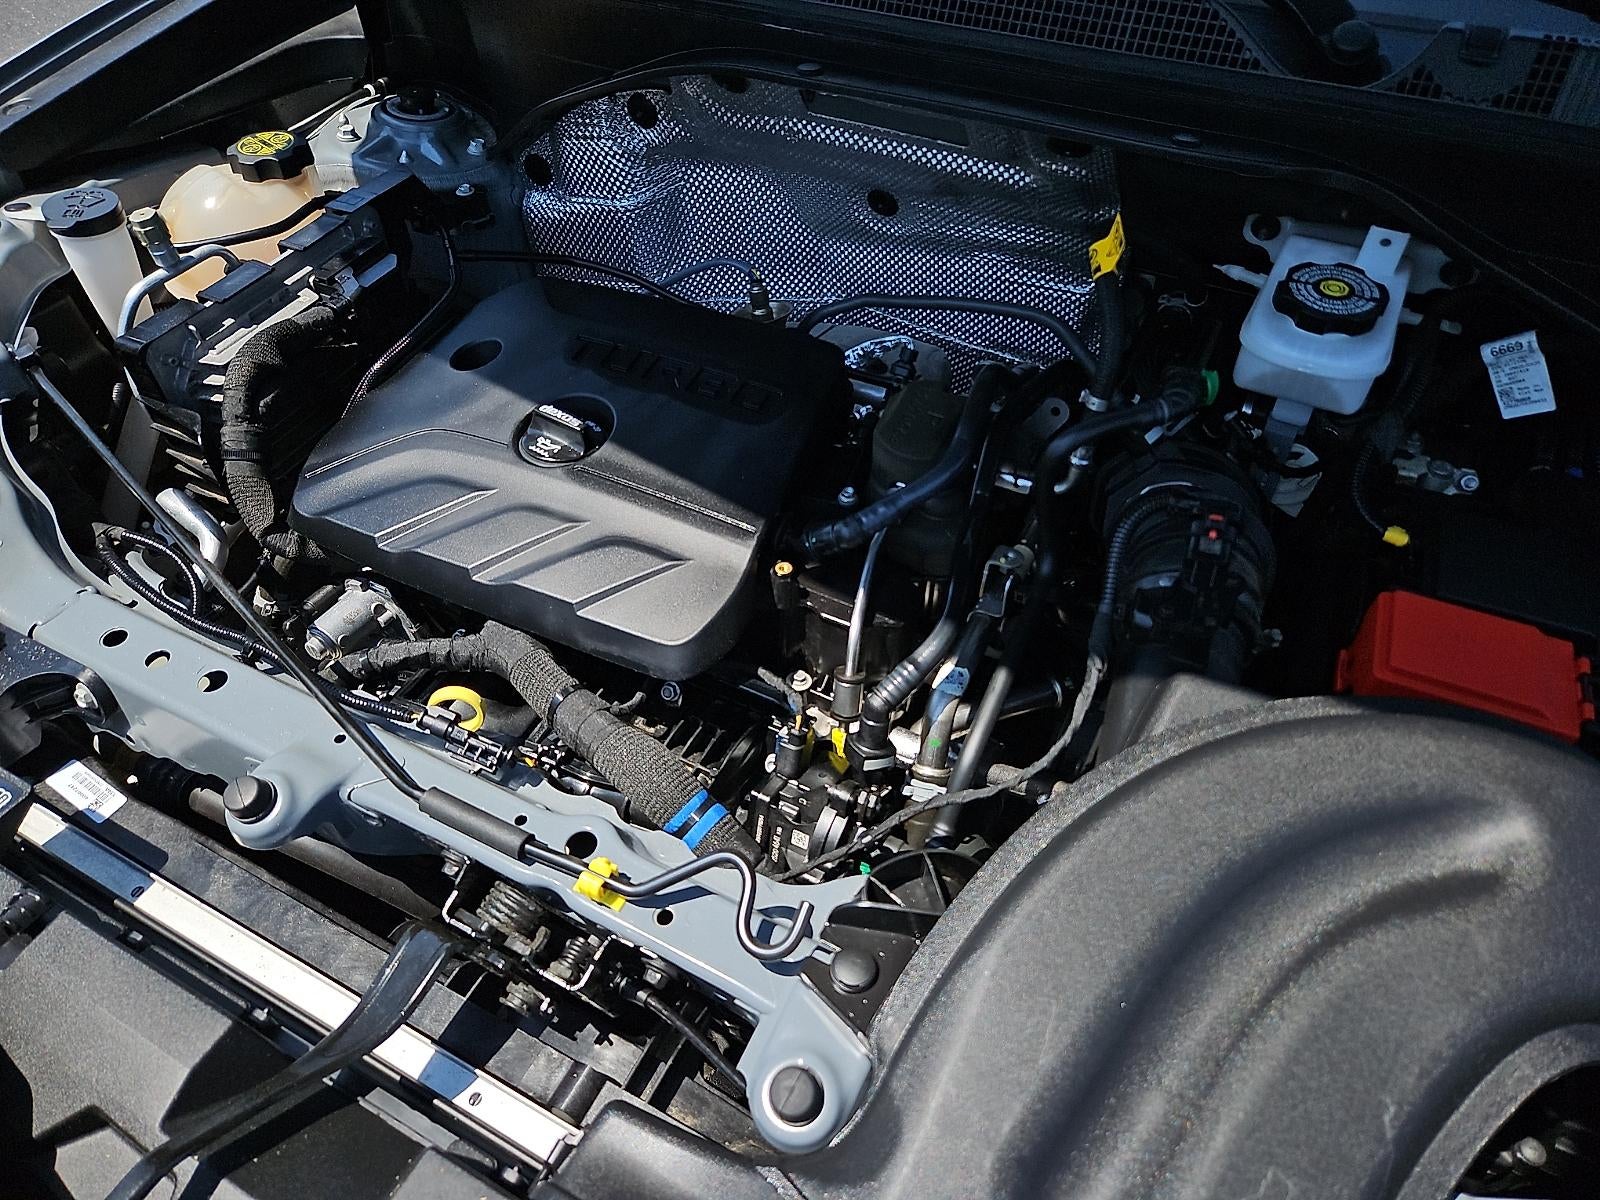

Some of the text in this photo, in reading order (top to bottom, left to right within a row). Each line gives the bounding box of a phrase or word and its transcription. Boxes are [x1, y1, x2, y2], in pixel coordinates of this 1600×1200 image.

[1490, 341, 1524, 357] 6669
[569, 334, 785, 414] TURBO
[538, 404, 584, 427] dexos
